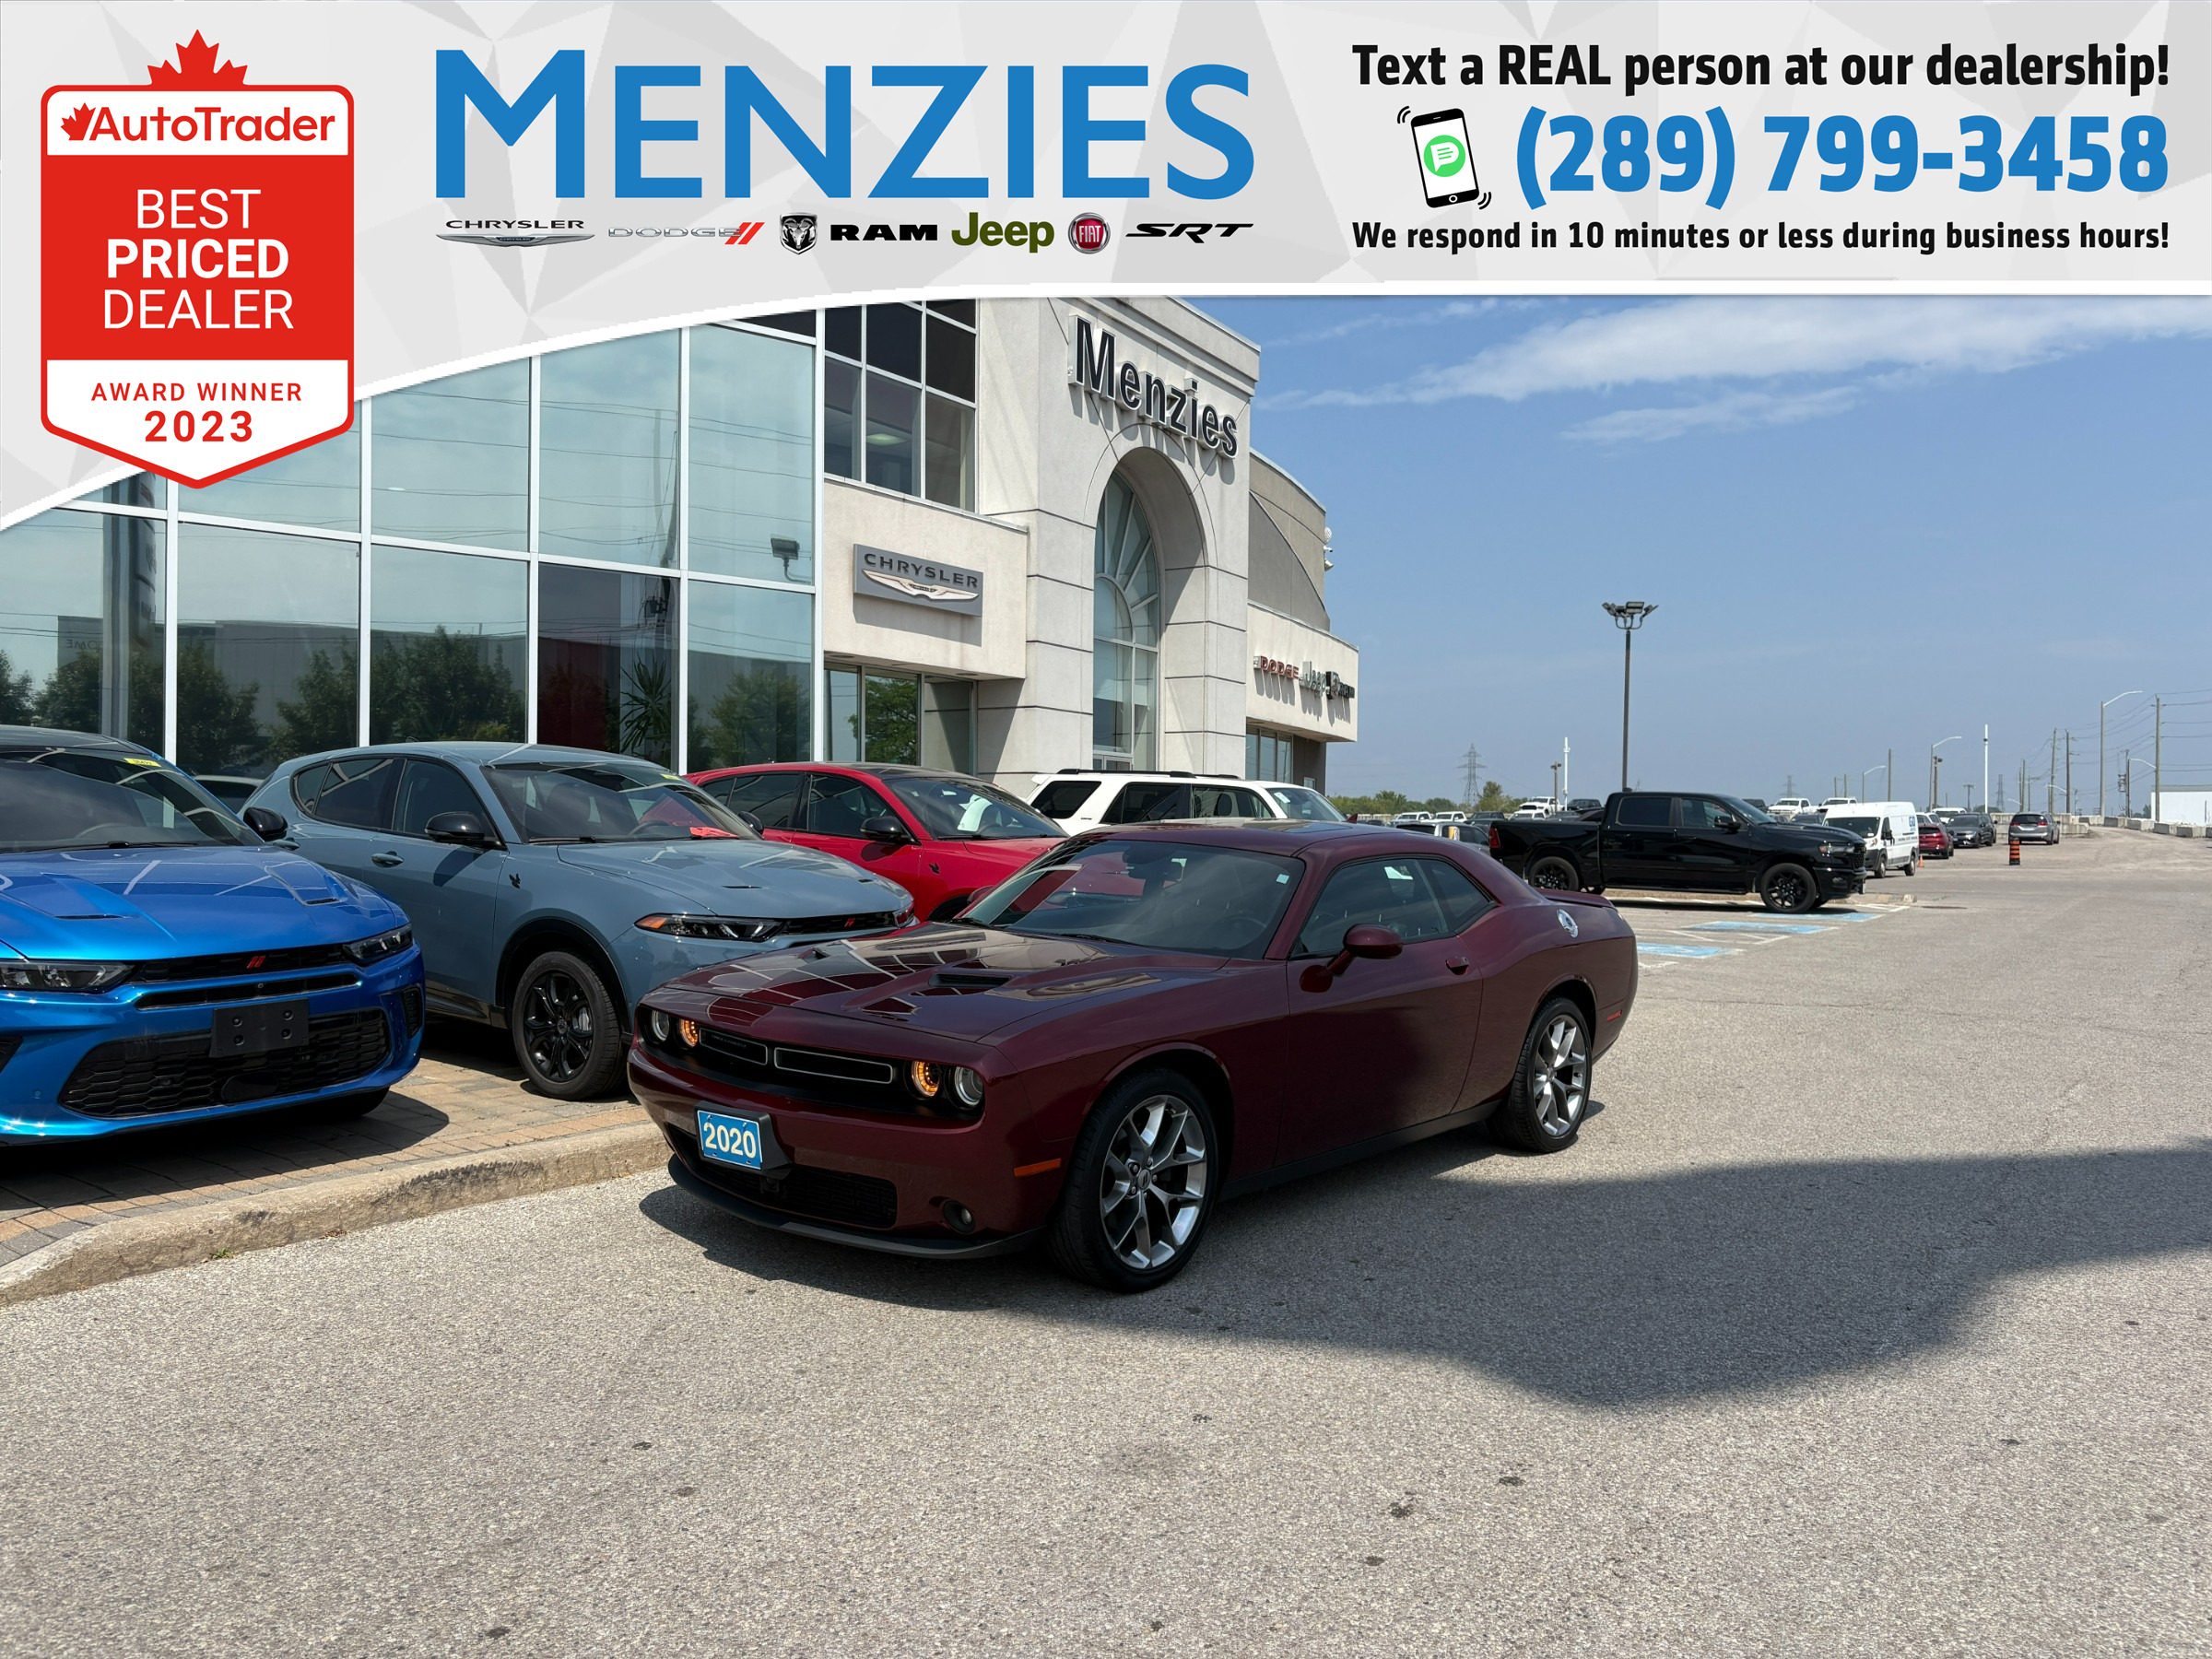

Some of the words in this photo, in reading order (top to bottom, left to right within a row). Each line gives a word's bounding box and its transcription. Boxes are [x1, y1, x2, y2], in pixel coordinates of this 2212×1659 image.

[1073, 314, 1239, 459] Menzies
[864, 553, 978, 588] CHRYSLER
[1260, 655, 1300, 679] DODGE
[703, 1122, 757, 1159] 2020
